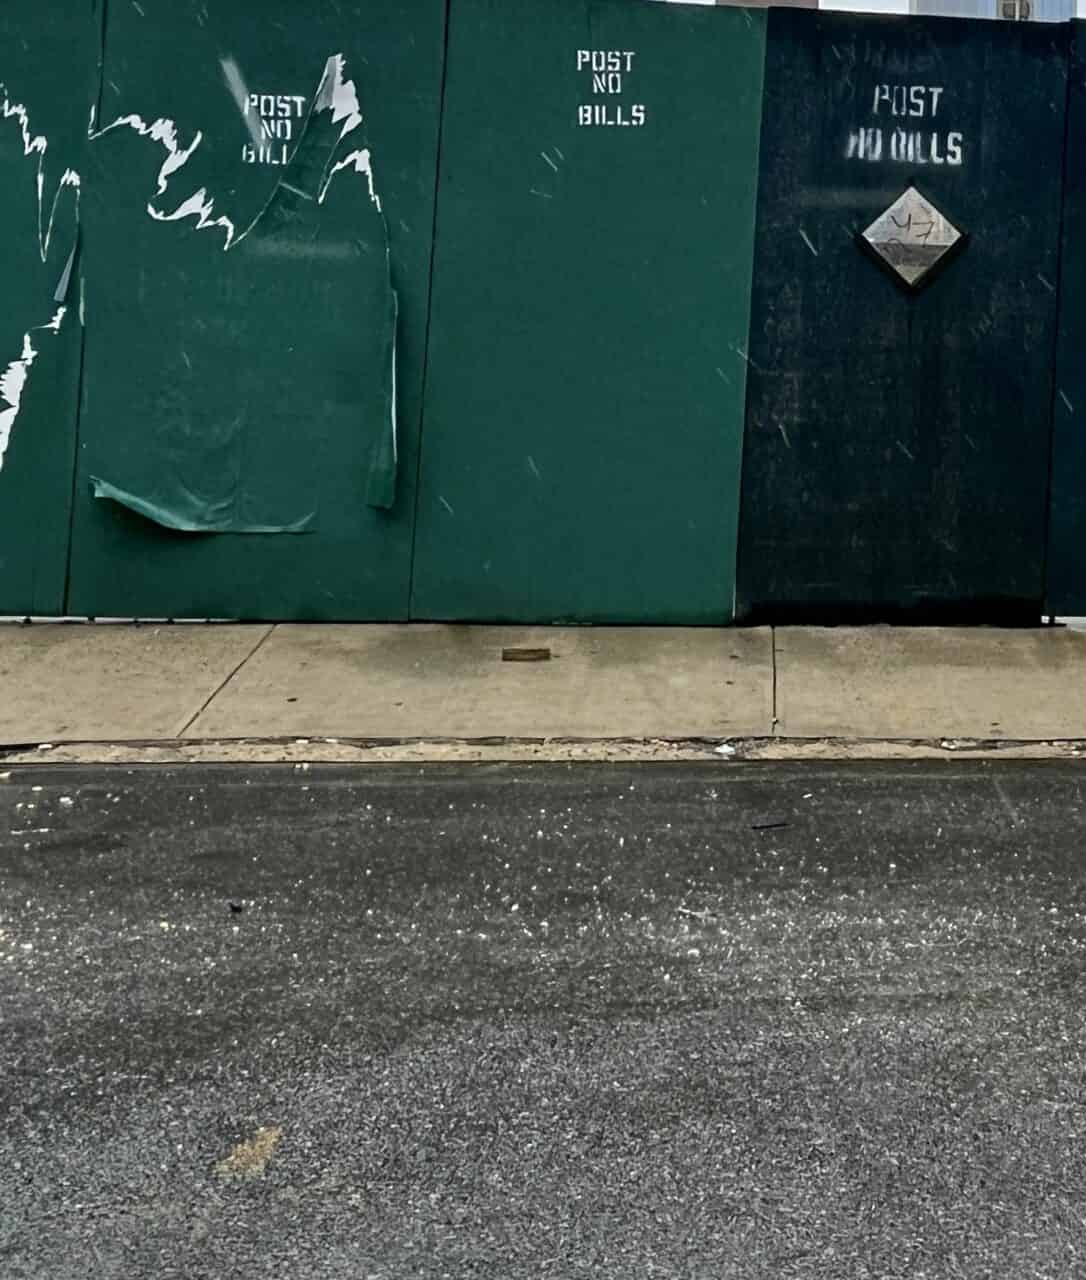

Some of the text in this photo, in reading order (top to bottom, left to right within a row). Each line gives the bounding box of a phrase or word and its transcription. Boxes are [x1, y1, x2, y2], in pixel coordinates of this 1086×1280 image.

[576, 49, 636, 72] POST
[592, 72, 622, 94] NO
[243, 93, 307, 118] POST
[872, 84, 944, 117] POST
[578, 104, 646, 126] BILLS
[260, 119, 292, 140] NO
[241, 143, 288, 166] BILL
[845, 126, 963, 165] NO BILLS
